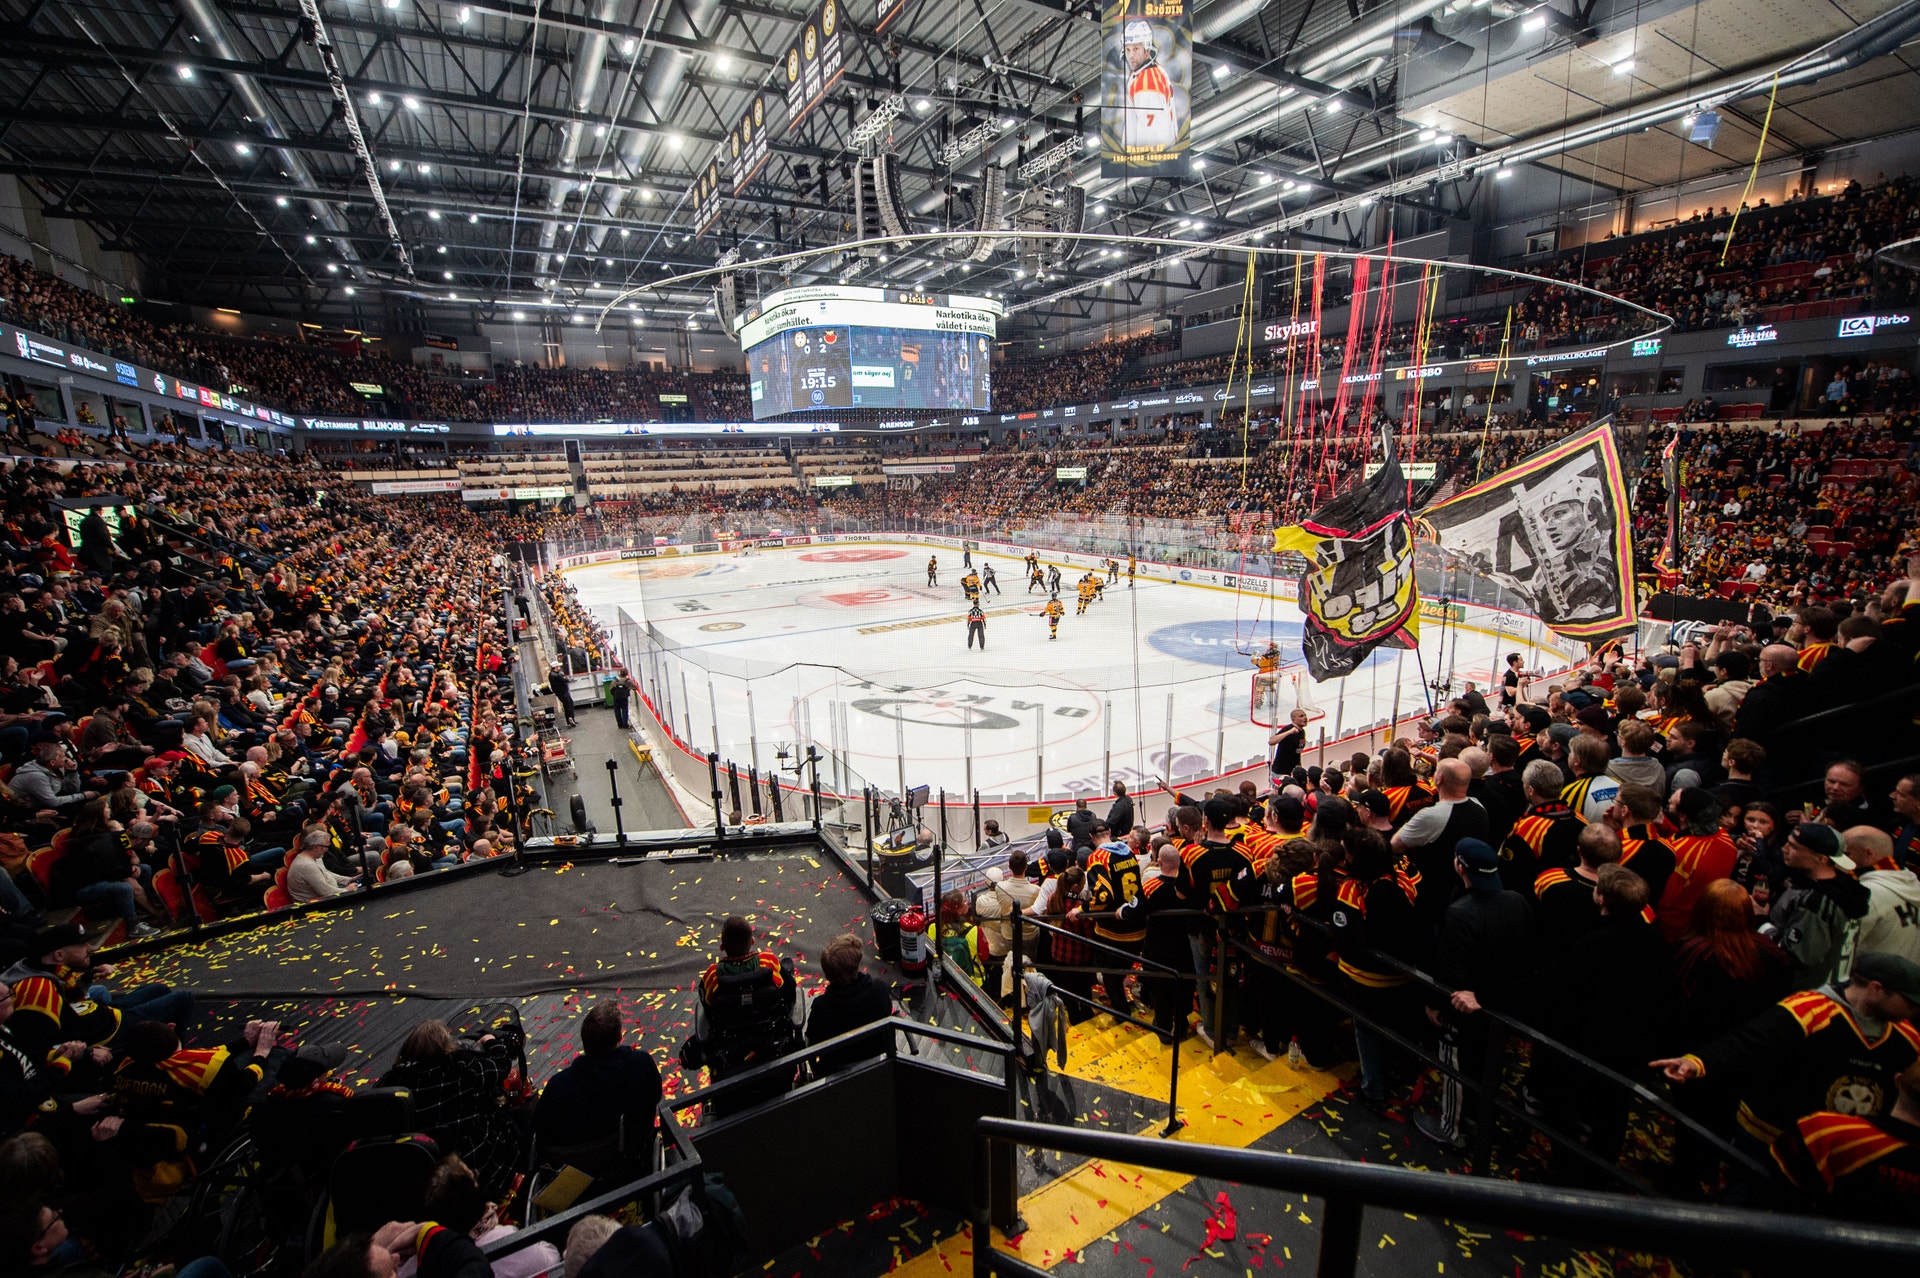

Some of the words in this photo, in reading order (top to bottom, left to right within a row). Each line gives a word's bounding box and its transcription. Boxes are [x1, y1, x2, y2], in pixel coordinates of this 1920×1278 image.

[824, 51, 841, 80] 1970
[806, 75, 820, 101] 1971
[790, 95, 802, 120] 1972
[1147, 114, 1154, 126] 7
[782, 308, 797, 317] ökar
[936, 310, 977, 321] Narkotika
[776, 317, 813, 330] samhället.
[936, 320, 962, 330] våldet
[1843, 319, 1870, 332] ICA
[1875, 314, 1910, 327] Järbo
[1265, 321, 1318, 341] Skybar
[804, 345, 811, 354] 0
[820, 343, 827, 353] 2
[1539, 350, 1608, 363] KONTROLLBOLAGET
[119, 363, 137, 378] STENA
[801, 376, 837, 390] 19:15
[314, 420, 359, 430] VÄSTANHEDE
[363, 420, 406, 431] BILINORR
[962, 417, 979, 426] ABB
[68, 516, 81, 526] Tac
[622, 550, 655, 558] DIVELLO
[1121, 871, 1139, 903] 6
[1099, 890, 1108, 902] 6
